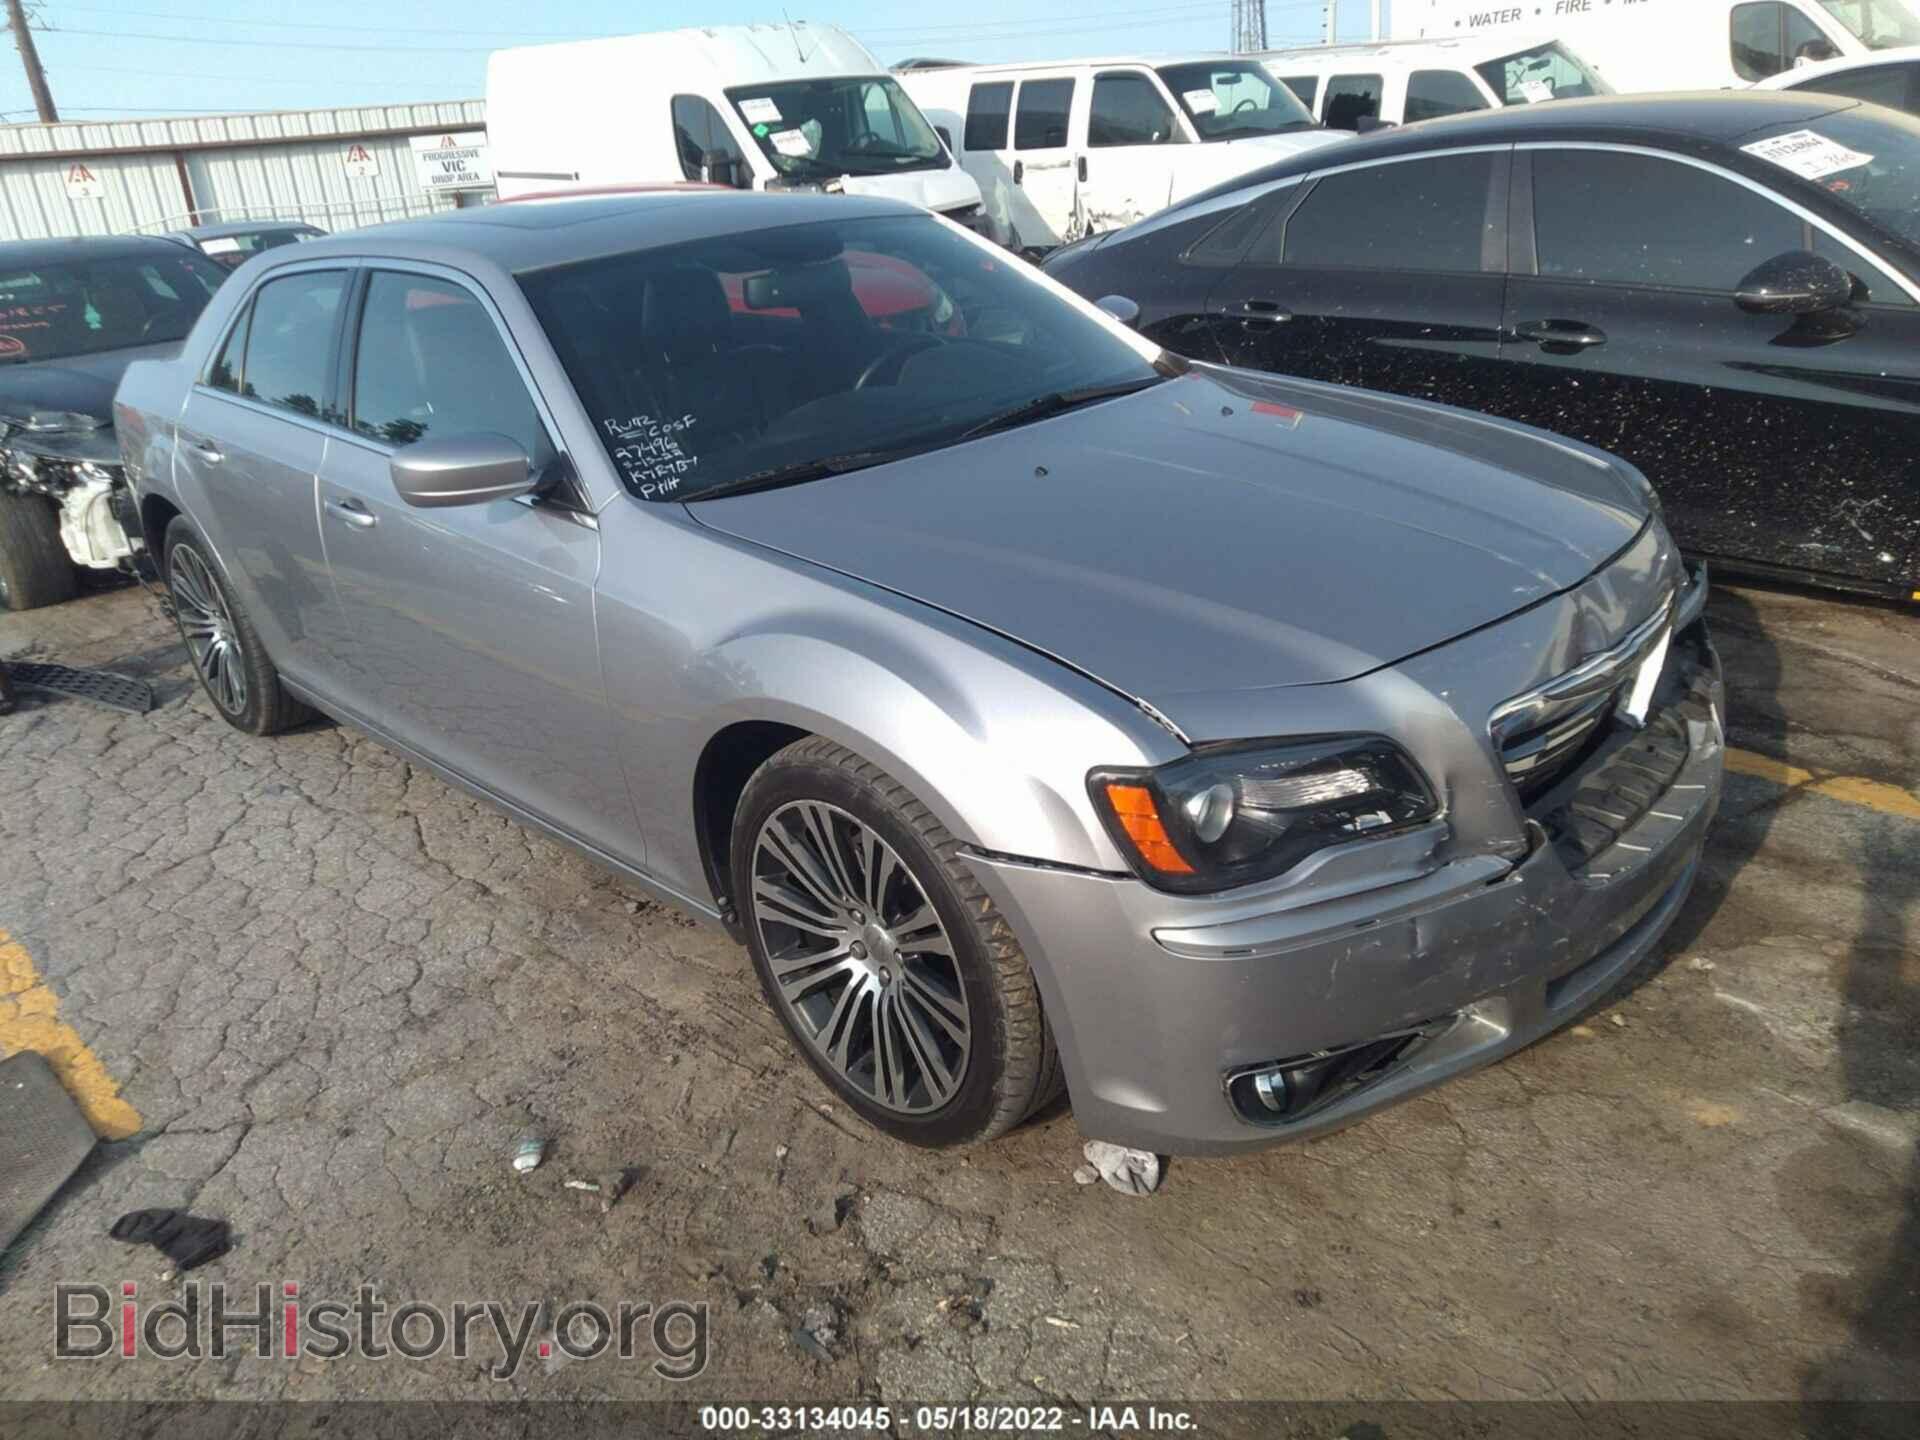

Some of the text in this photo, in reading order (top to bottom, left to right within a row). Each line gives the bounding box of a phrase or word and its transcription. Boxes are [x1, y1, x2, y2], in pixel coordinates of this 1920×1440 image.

[1469, 0, 1591, 27] WATER FIRE
[423, 149, 480, 161] PROGRESSIVE
[442, 160, 466, 173] VIC
[432, 171, 480, 184] DROP AREA
